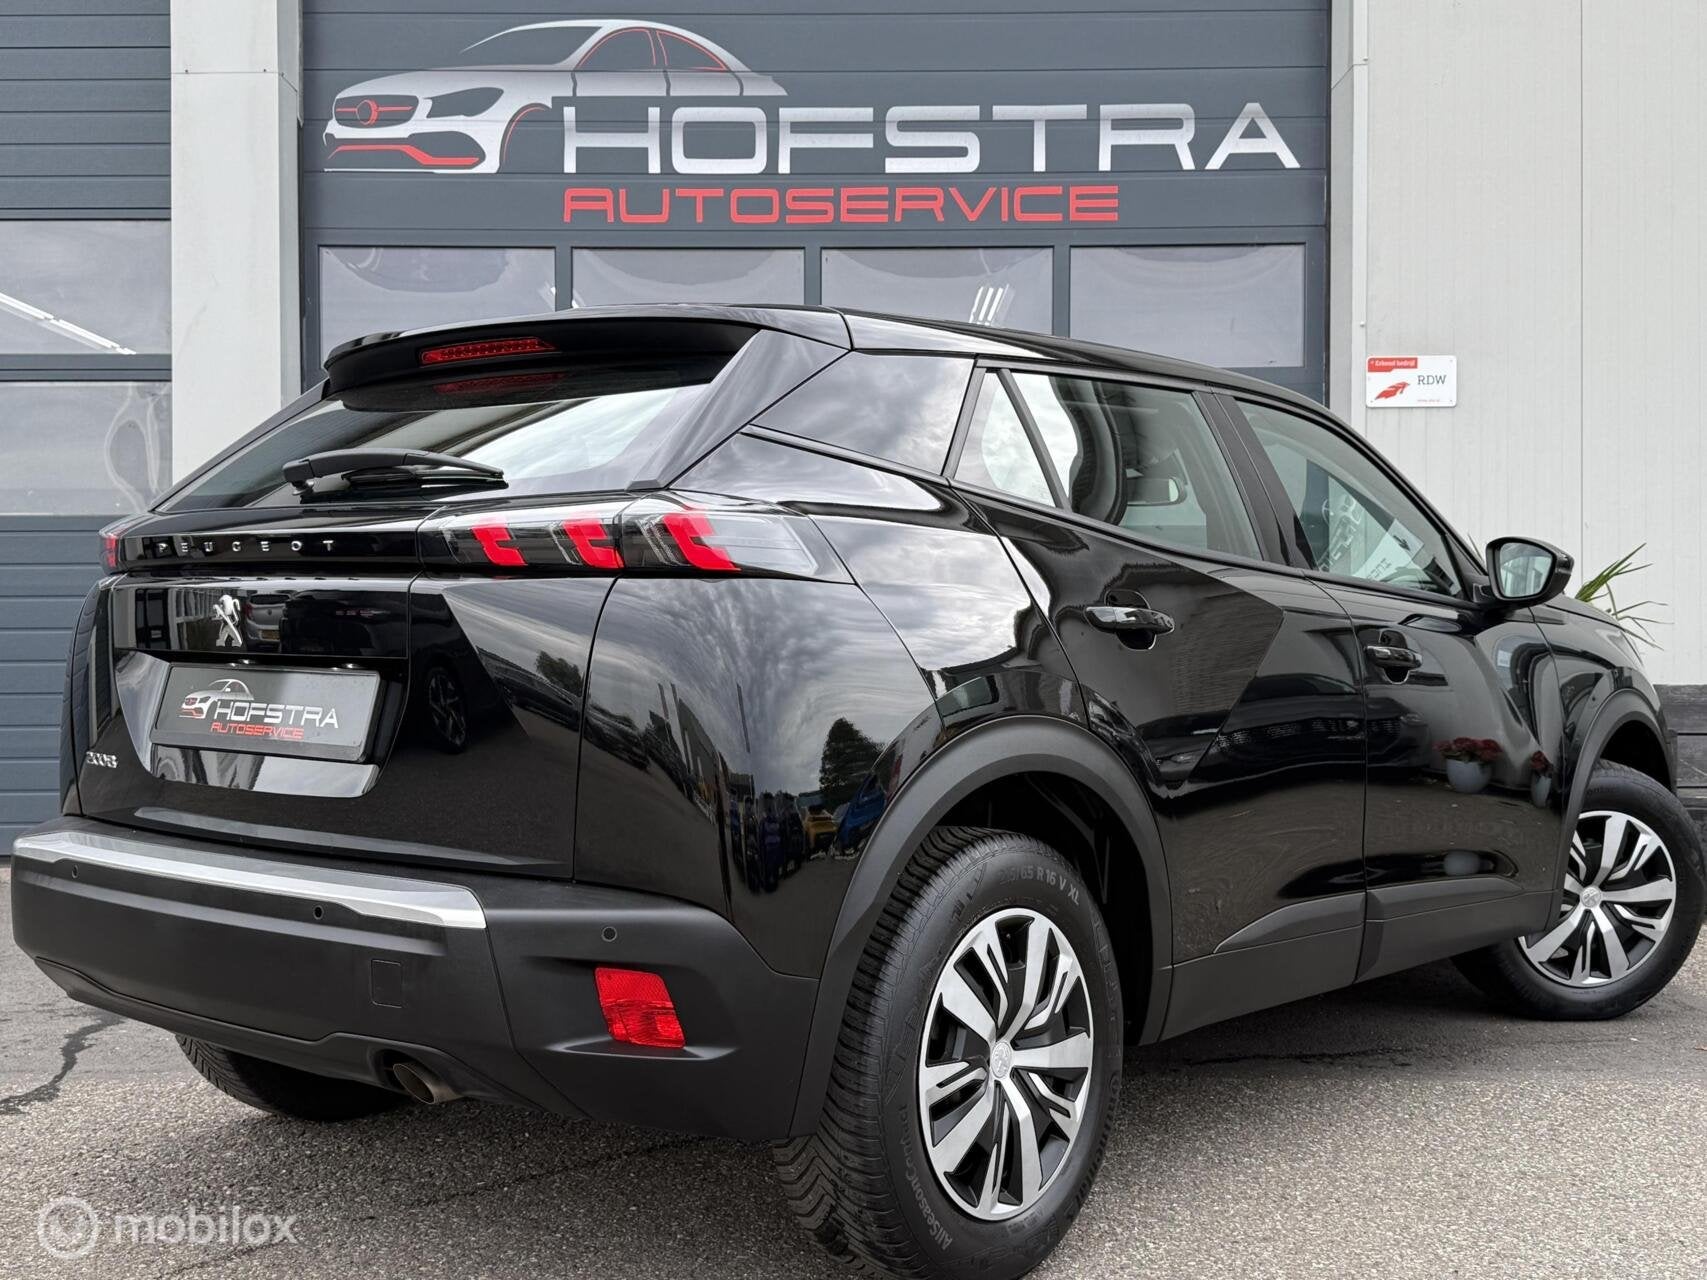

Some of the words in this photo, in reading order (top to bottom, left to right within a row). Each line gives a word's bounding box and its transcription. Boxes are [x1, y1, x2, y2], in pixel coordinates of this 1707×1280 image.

[563, 102, 1301, 174] HOFSTRA
[562, 186, 1119, 224] AUTOSERVICE
[1417, 375, 1446, 385] RDW
[157, 539, 334, 553] PEUGEOT
[214, 700, 339, 728] HOFSTRA
[210, 722, 304, 739] AUTOSERVICE
[1068, 883, 1079, 906] XL
